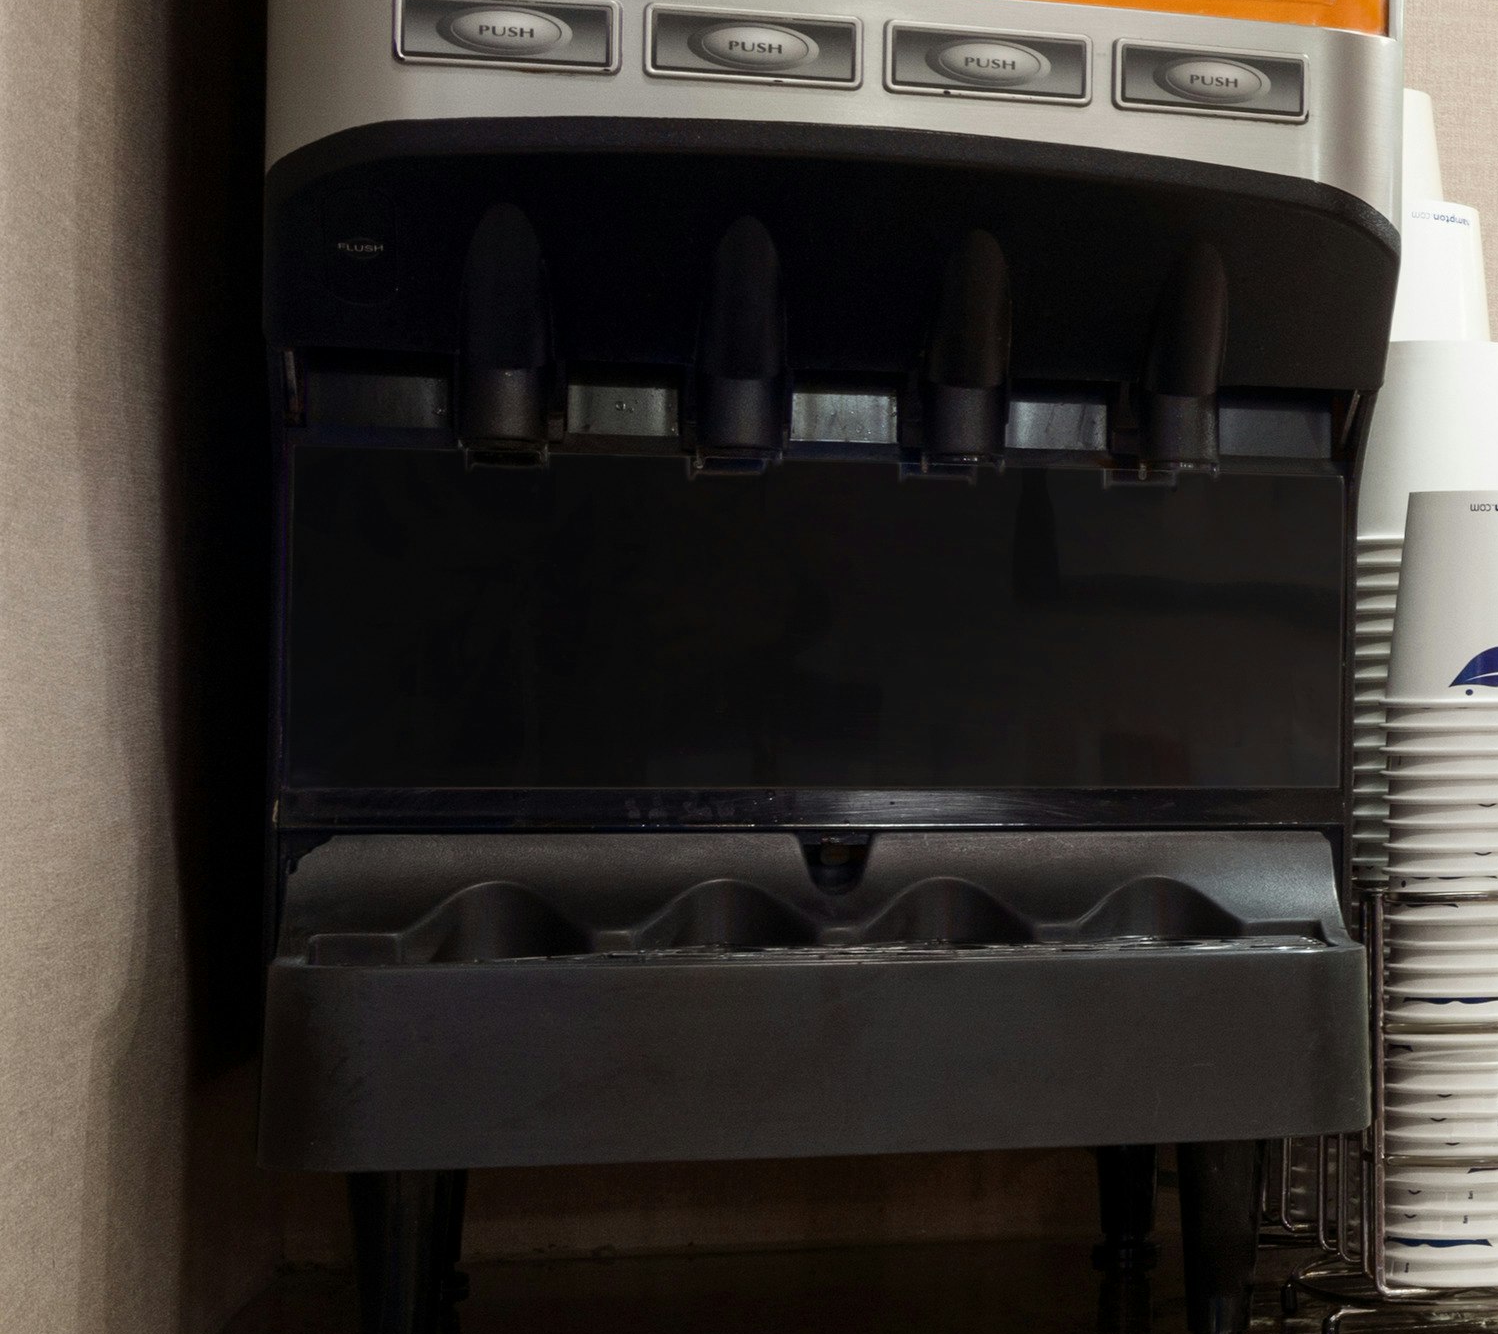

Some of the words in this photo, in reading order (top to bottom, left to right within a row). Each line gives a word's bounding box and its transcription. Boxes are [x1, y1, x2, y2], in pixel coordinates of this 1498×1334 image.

[478, 23, 535, 39] PUSH
[727, 39, 783, 54] PUSH
[964, 56, 1017, 71] PUSH
[1190, 73, 1239, 88] PUSH
[338, 242, 384, 252] FLUSH
